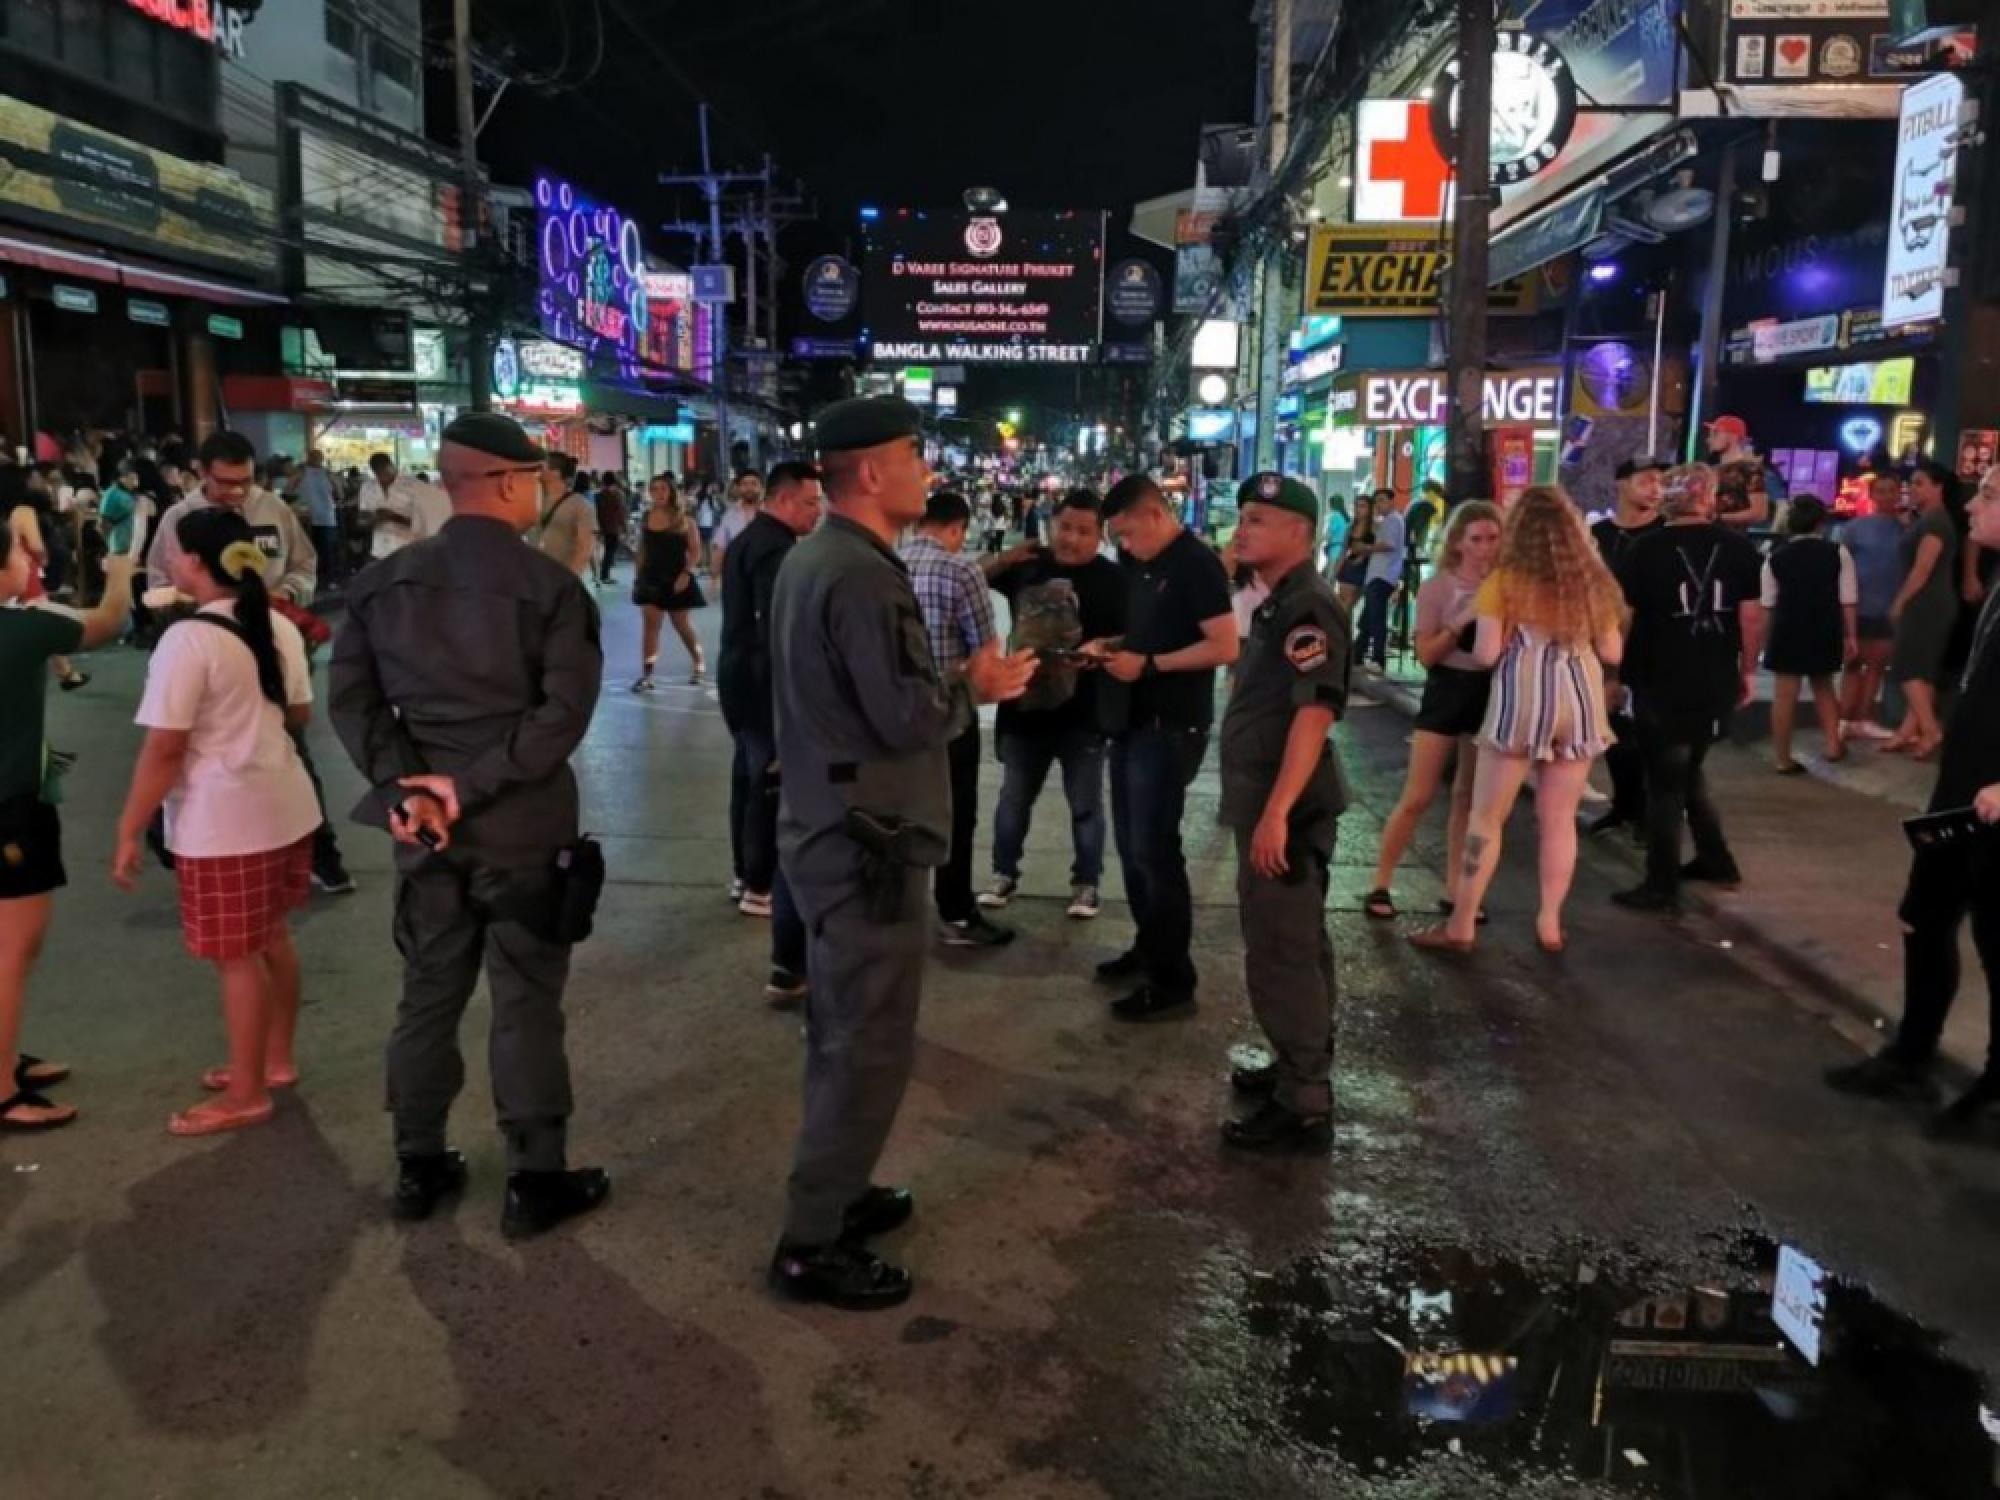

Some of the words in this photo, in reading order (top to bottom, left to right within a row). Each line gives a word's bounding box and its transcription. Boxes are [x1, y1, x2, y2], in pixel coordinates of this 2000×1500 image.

[1903, 97, 1954, 142] PITBULL
[933, 280, 968, 295] SALES
[971, 280, 1027, 295] GALLERY
[873, 343, 941, 360] BANGLA
[946, 343, 1024, 361] WALKING
[1028, 344, 1090, 362] STREET
[1367, 377, 1556, 420] EXCHNGE
